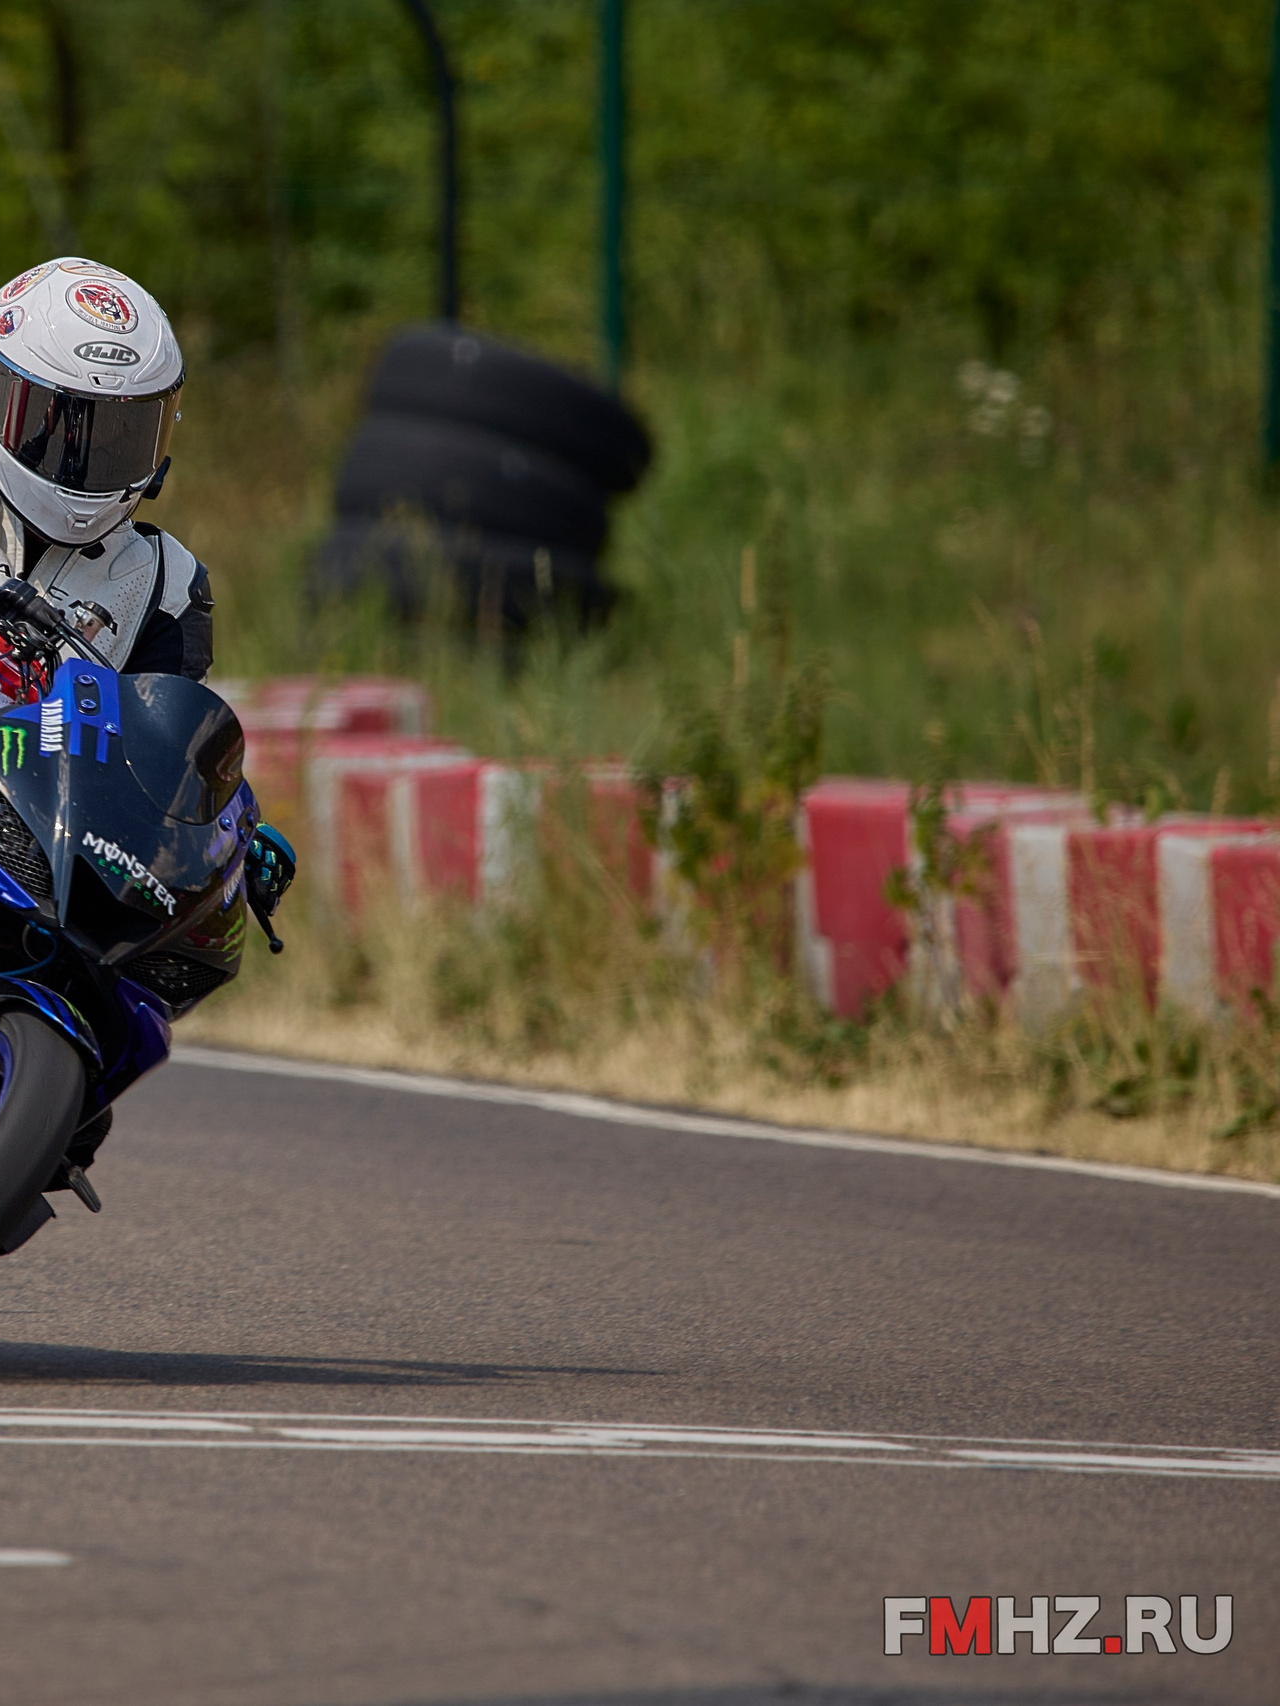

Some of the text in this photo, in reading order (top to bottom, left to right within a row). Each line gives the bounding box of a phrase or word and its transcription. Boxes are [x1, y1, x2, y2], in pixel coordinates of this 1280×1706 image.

[82, 345, 133, 362] HJC
[41, 698, 63, 752] YAMAHA
[82, 831, 177, 916] MONSTER
[97, 858, 159, 907] ENERGY
